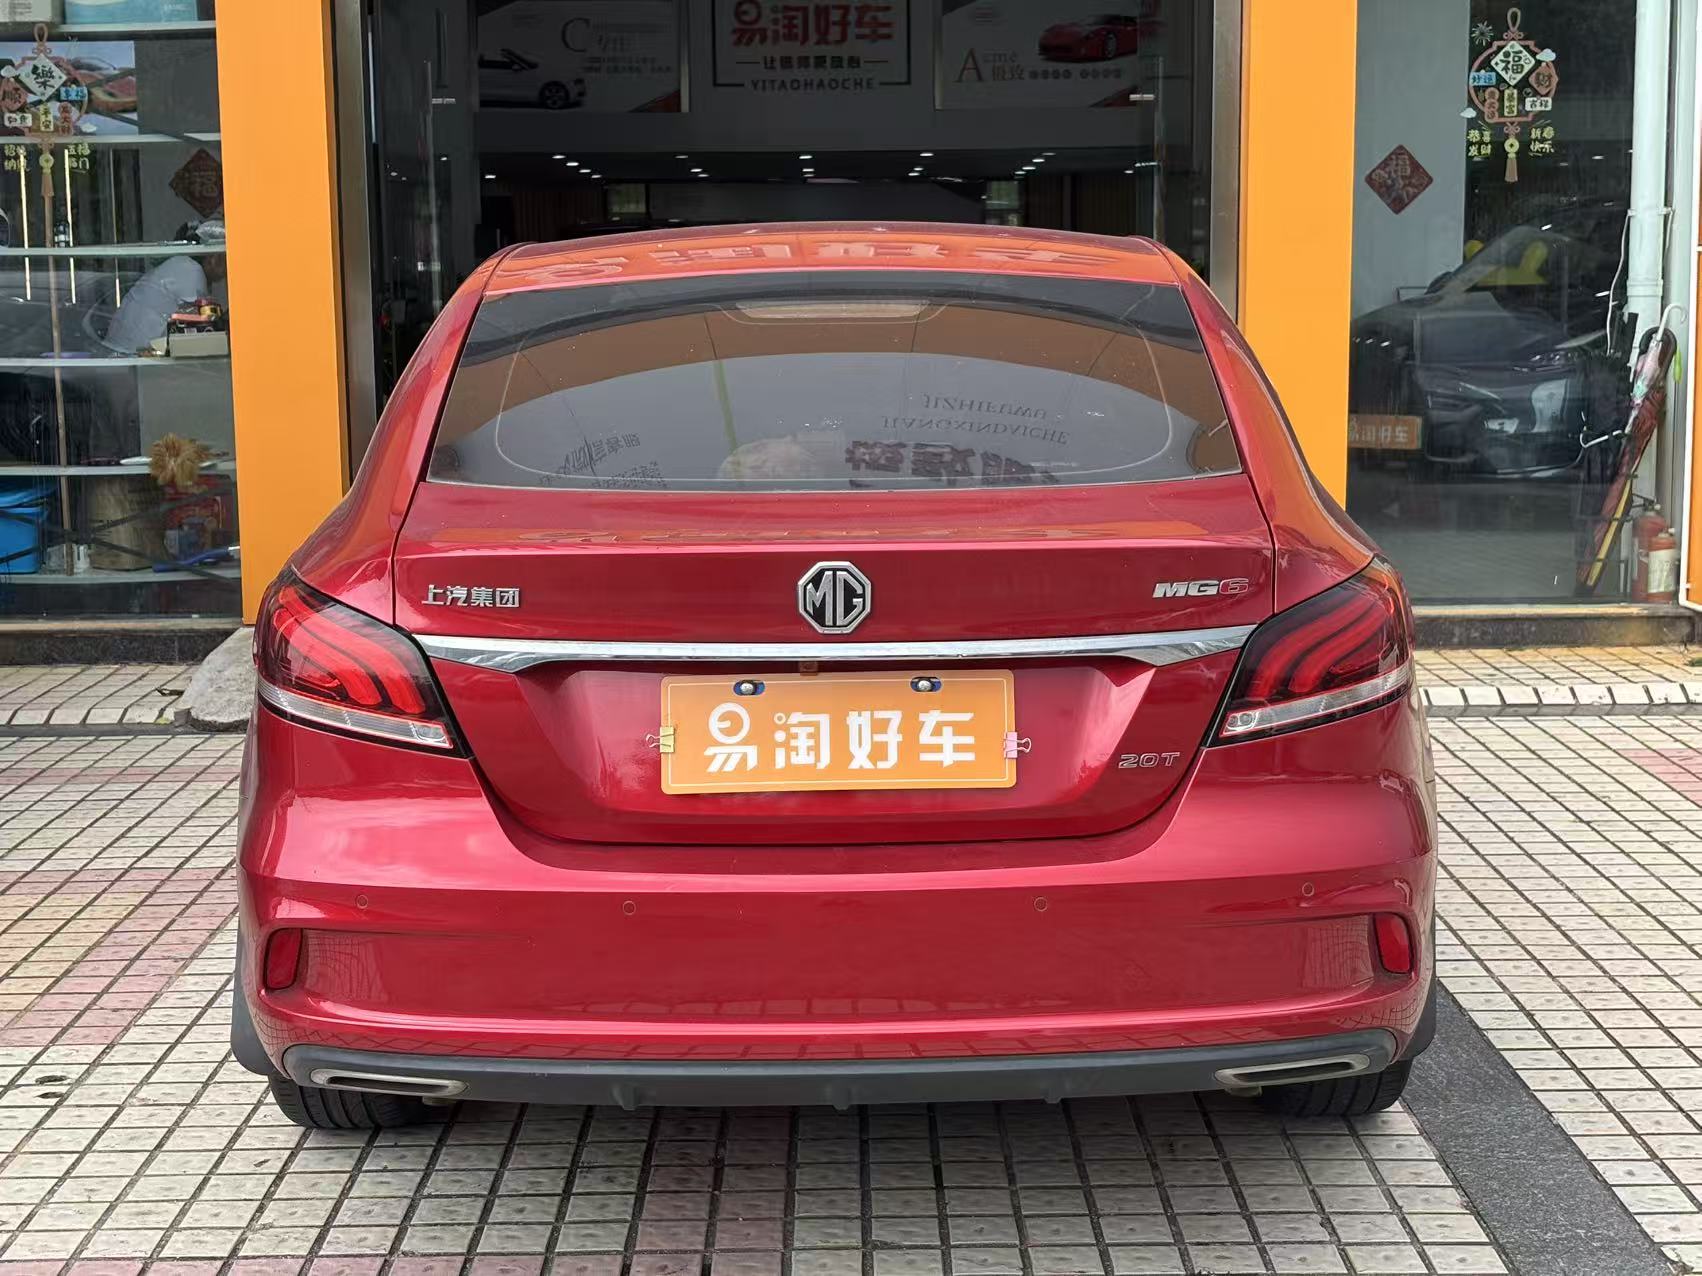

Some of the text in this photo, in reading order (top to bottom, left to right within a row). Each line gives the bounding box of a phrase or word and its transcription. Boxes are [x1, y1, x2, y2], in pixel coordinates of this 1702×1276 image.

[731, 0, 895, 46] 易淘好车
[1499, 50, 1525, 75] 福
[750, 78, 874, 92] YITAOHAOCHE
[421, 584, 521, 609] 上汽集团
[806, 569, 864, 627] MG
[1152, 577, 1249, 598] MG6
[703, 701, 976, 773] 易淘好车
[1118, 752, 1180, 769] 20T
